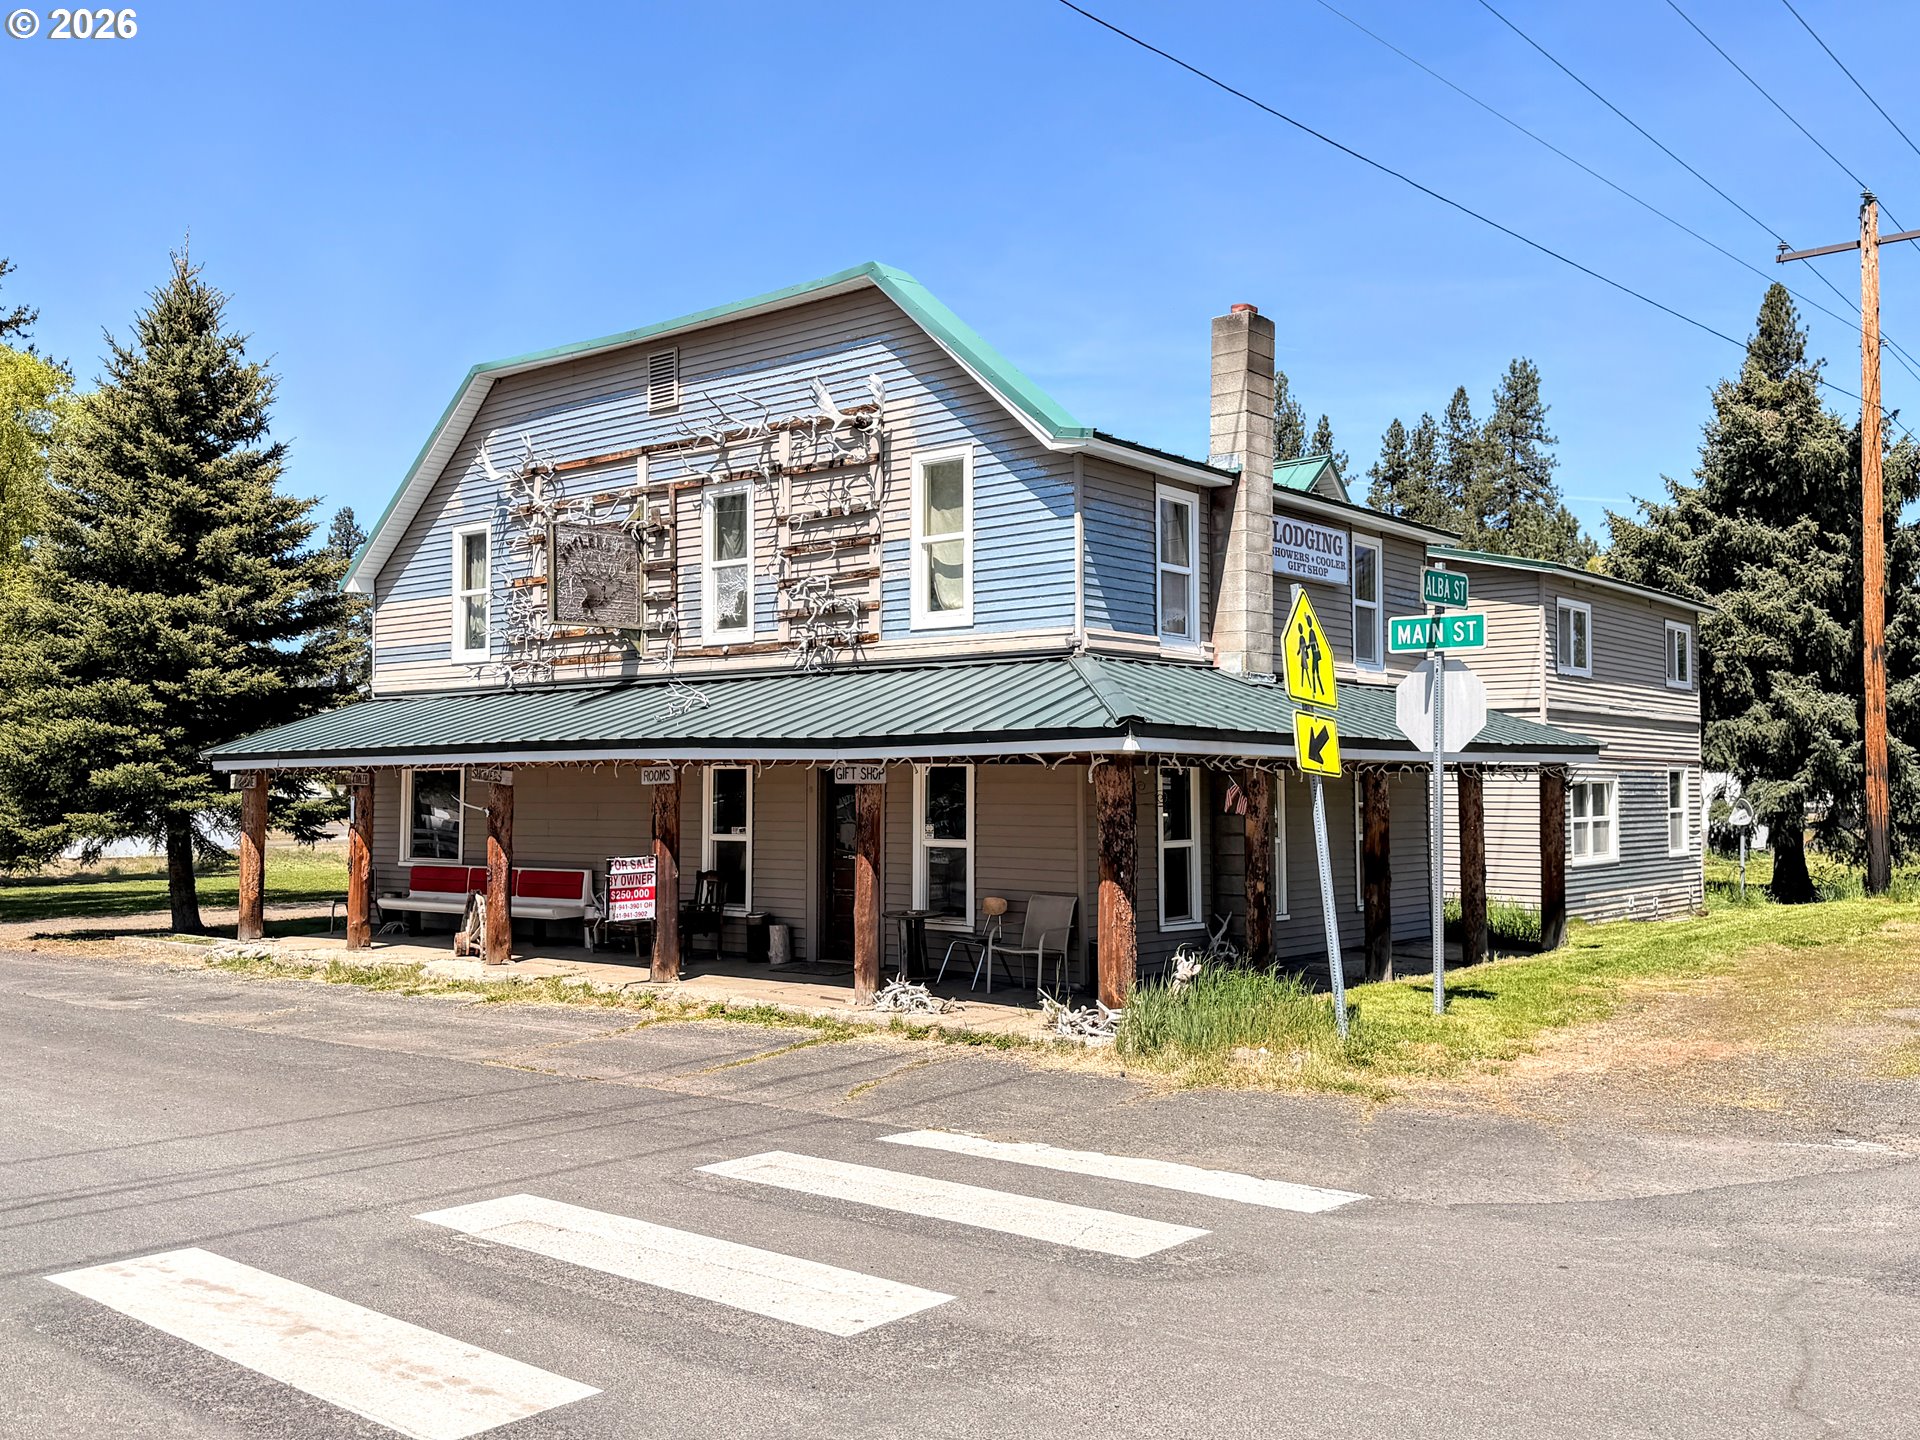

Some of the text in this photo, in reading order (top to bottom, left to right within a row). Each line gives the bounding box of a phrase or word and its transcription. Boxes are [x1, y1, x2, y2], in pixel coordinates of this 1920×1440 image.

[1272, 521, 1343, 556] LODGING
[1288, 561, 1329, 577] GIFT SHOP
[1316, 555, 1346, 570] COOLER
[1426, 575, 1465, 601] ALBA ST
[1397, 621, 1477, 645] MAIN ST
[643, 769, 671, 782] ROOMS
[835, 766, 885, 780] GIFT SHOP
[610, 858, 655, 871] FOR SALE
[621, 873, 653, 886] OWNER
[610, 888, 650, 900] $250,000
[609, 902, 643, 911] 41-941-3901
